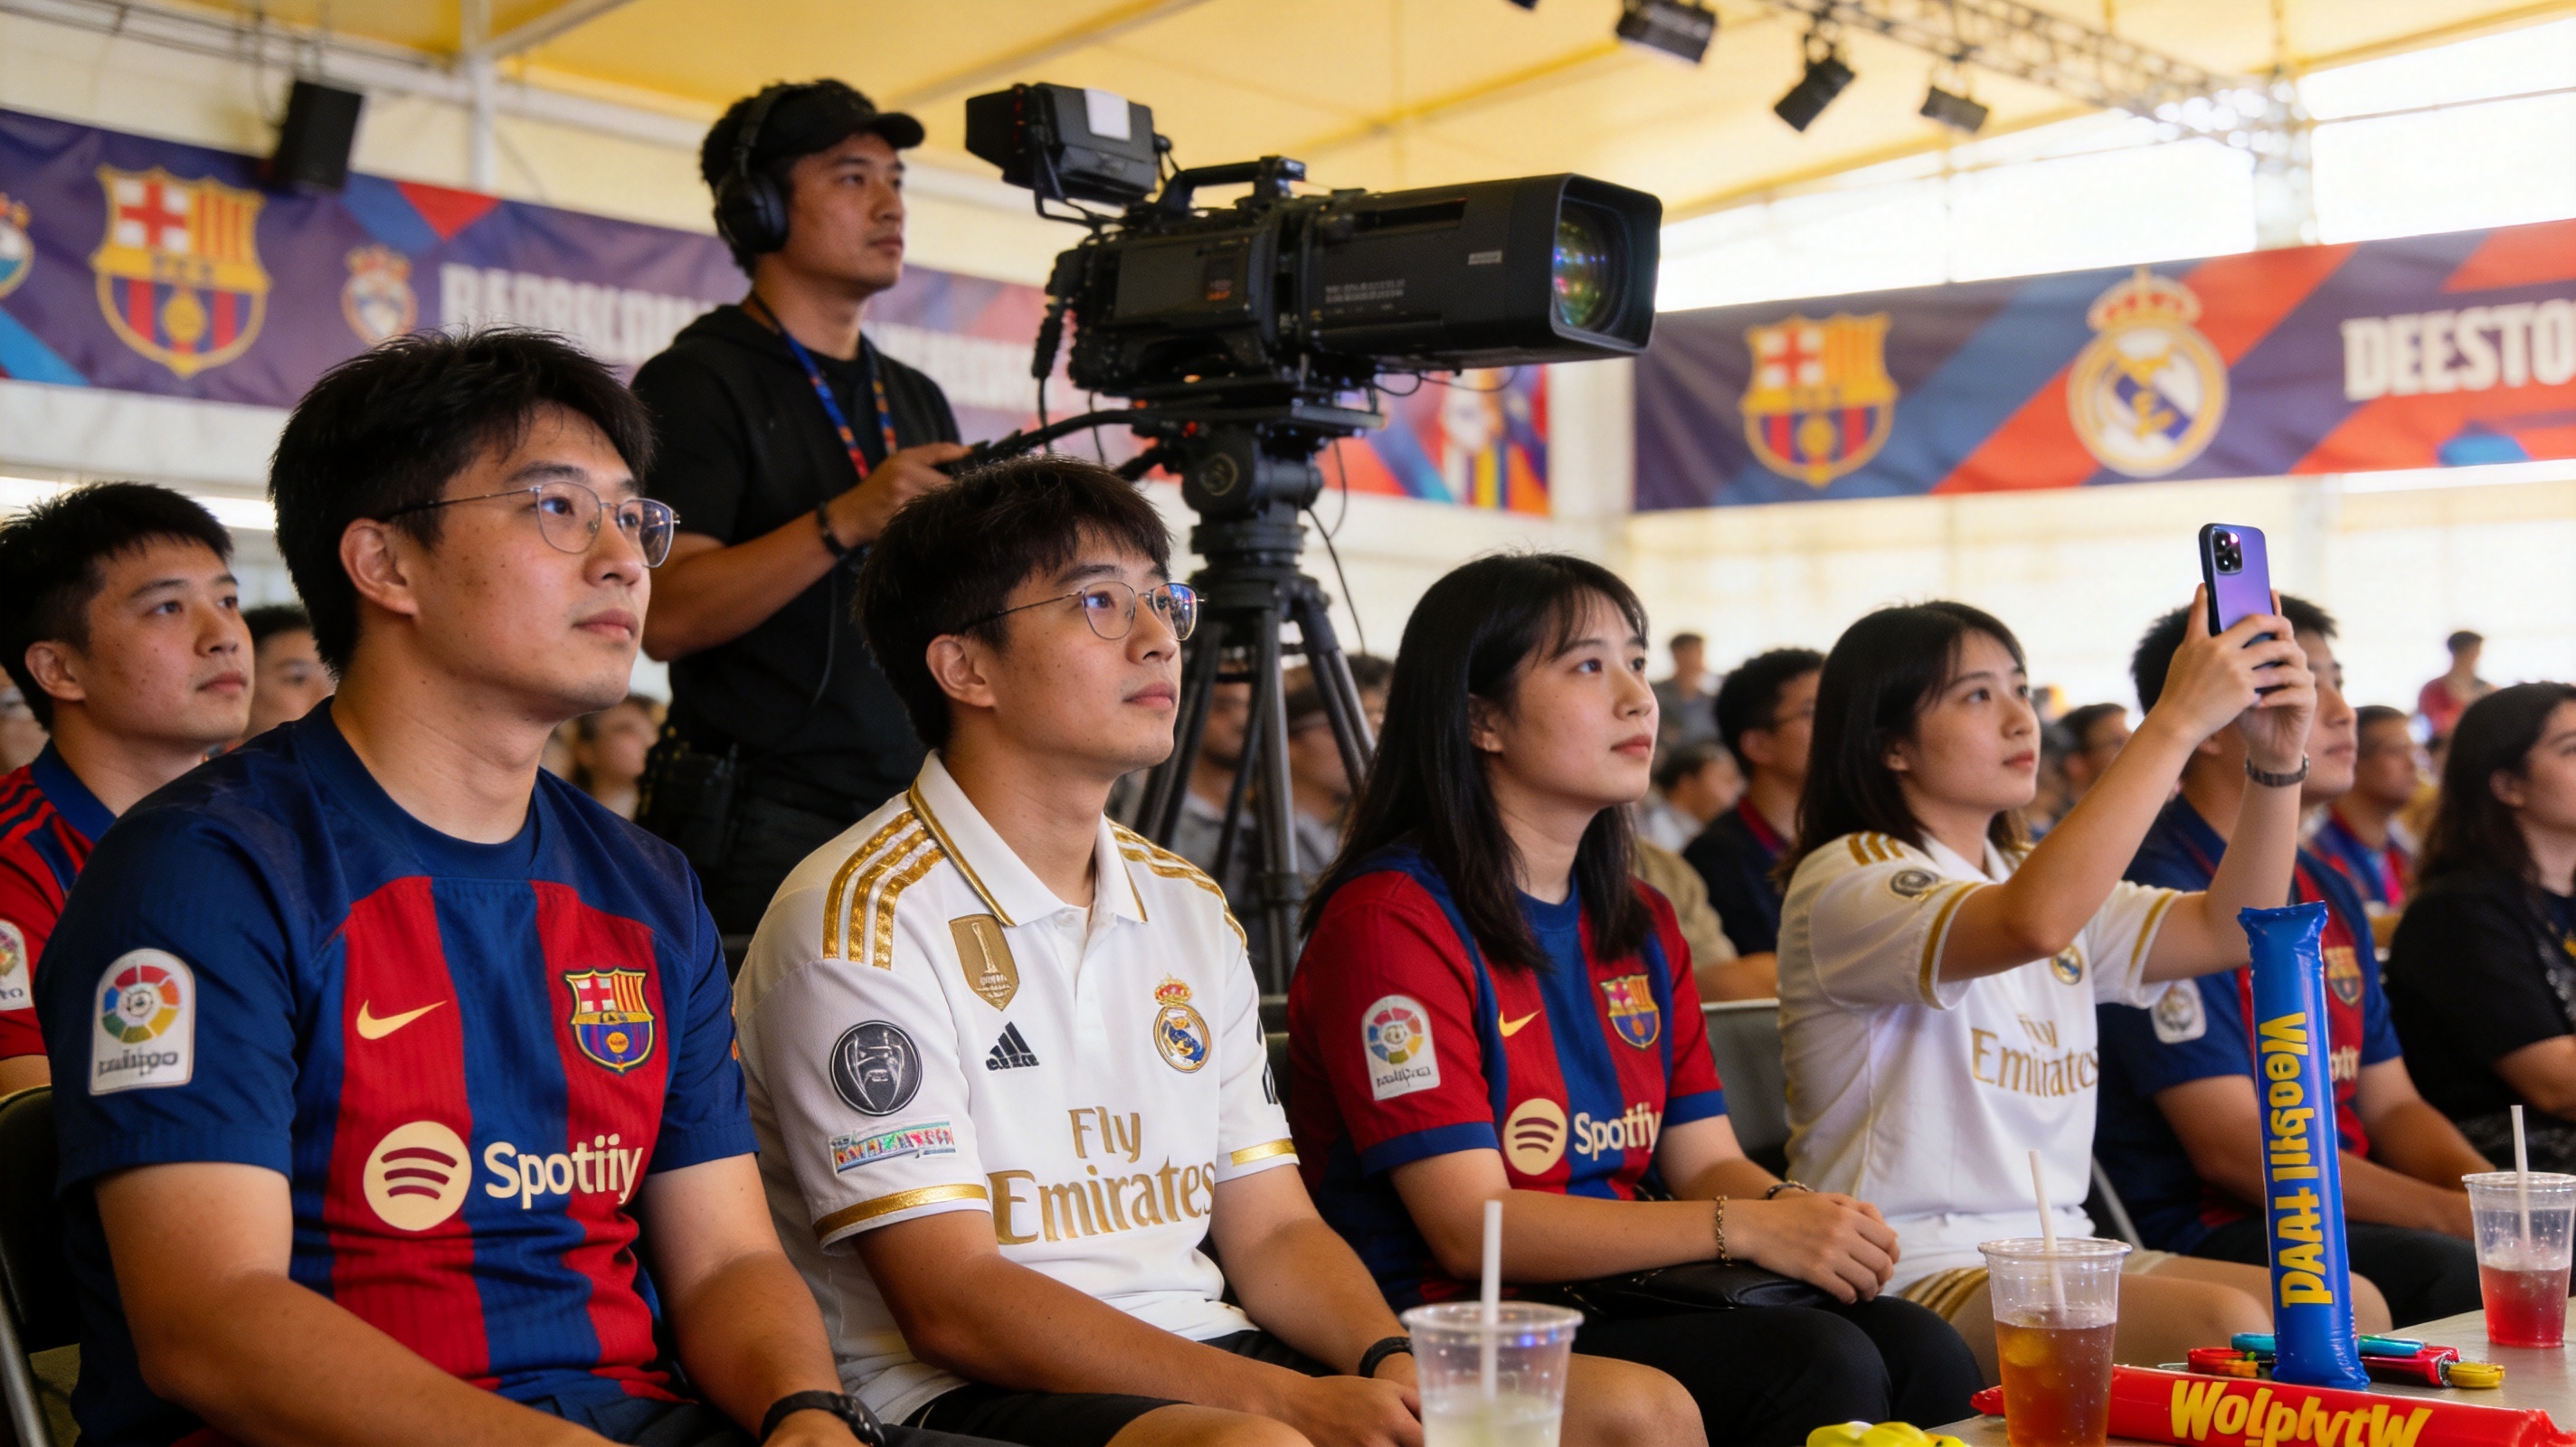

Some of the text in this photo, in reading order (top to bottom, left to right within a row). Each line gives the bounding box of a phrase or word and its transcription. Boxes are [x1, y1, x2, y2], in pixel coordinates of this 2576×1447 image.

[2340, 298, 2576, 402] DEESTO
[1068, 1106, 1141, 1163] Fly
[986, 1155, 1217, 1245] Emirates
